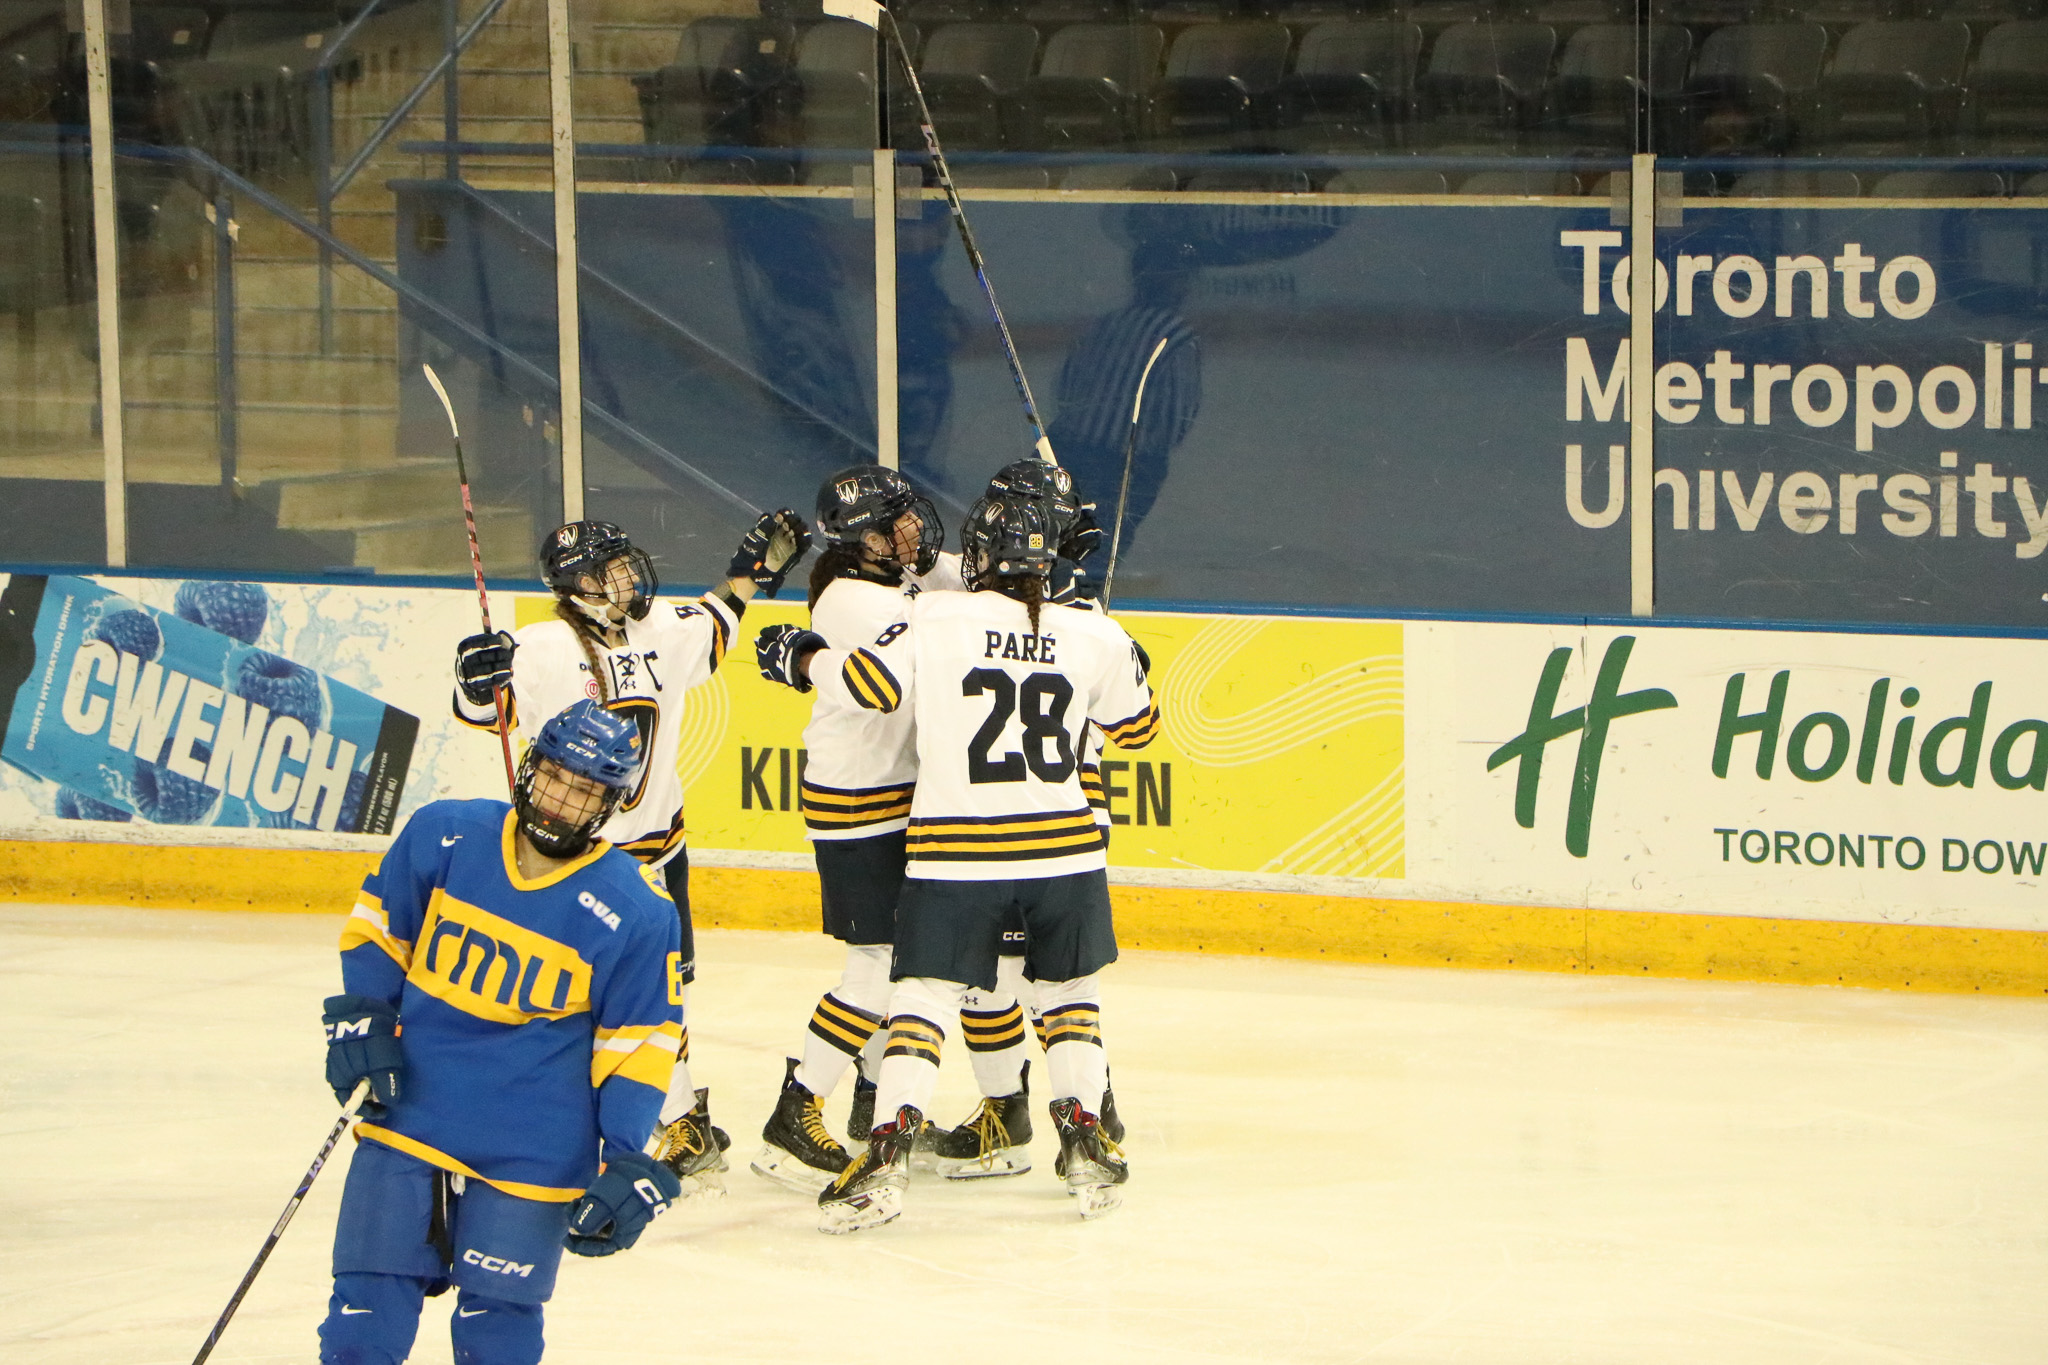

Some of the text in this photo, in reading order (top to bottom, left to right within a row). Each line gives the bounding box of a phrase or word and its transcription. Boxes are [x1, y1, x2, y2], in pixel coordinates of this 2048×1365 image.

[1561, 231, 1937, 319] Toronto
[991, 480, 1009, 491] CCM
[847, 512, 871, 526] CCM
[1054, 504, 1074, 514] CCM
[560, 554, 583, 568] CCM
[985, 630, 1056, 664] PARÉ
[26, 594, 75, 751] SPORTS HYDRATION DRINK
[62, 640, 358, 832] CWENCH
[962, 667, 1076, 784] 28
[1711, 670, 2048, 792] Holida
[566, 742, 597, 759] CCM
[363, 752, 389, 831] RASPBERRY FLAVOR
[526, 822, 560, 842] CCM
[1713, 829, 1926, 871] TORONTO
[1942, 839, 2048, 876] DOW
[577, 890, 622, 932] OUA
[1003, 931, 1026, 941] CC
[308, 1121, 345, 1179] CCM
[578, 1203, 594, 1225] CCM
[462, 1248, 536, 1278] CCM
